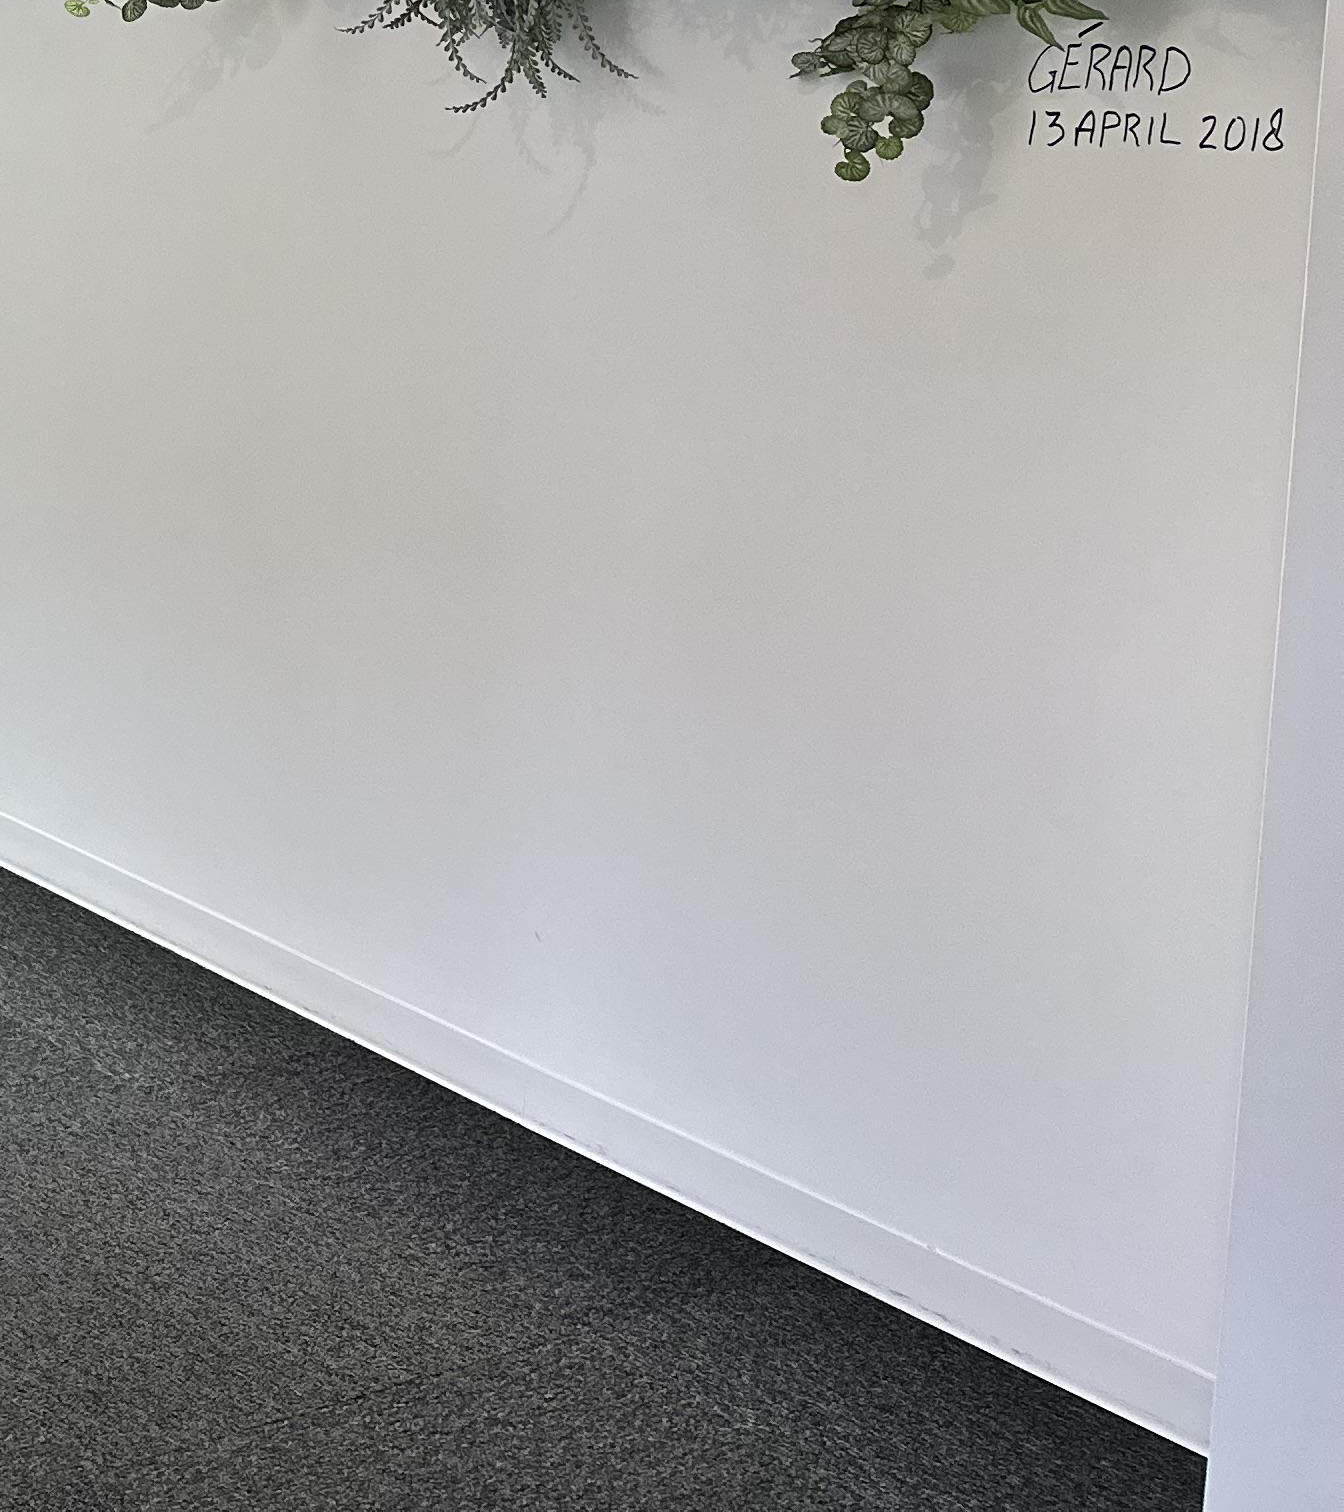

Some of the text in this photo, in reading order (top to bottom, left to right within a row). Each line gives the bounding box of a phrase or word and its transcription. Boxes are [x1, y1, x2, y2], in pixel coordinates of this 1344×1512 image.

[1028, 21, 1191, 96] GÉRARD
[1028, 107, 1285, 152] 13 APRIL 2018
